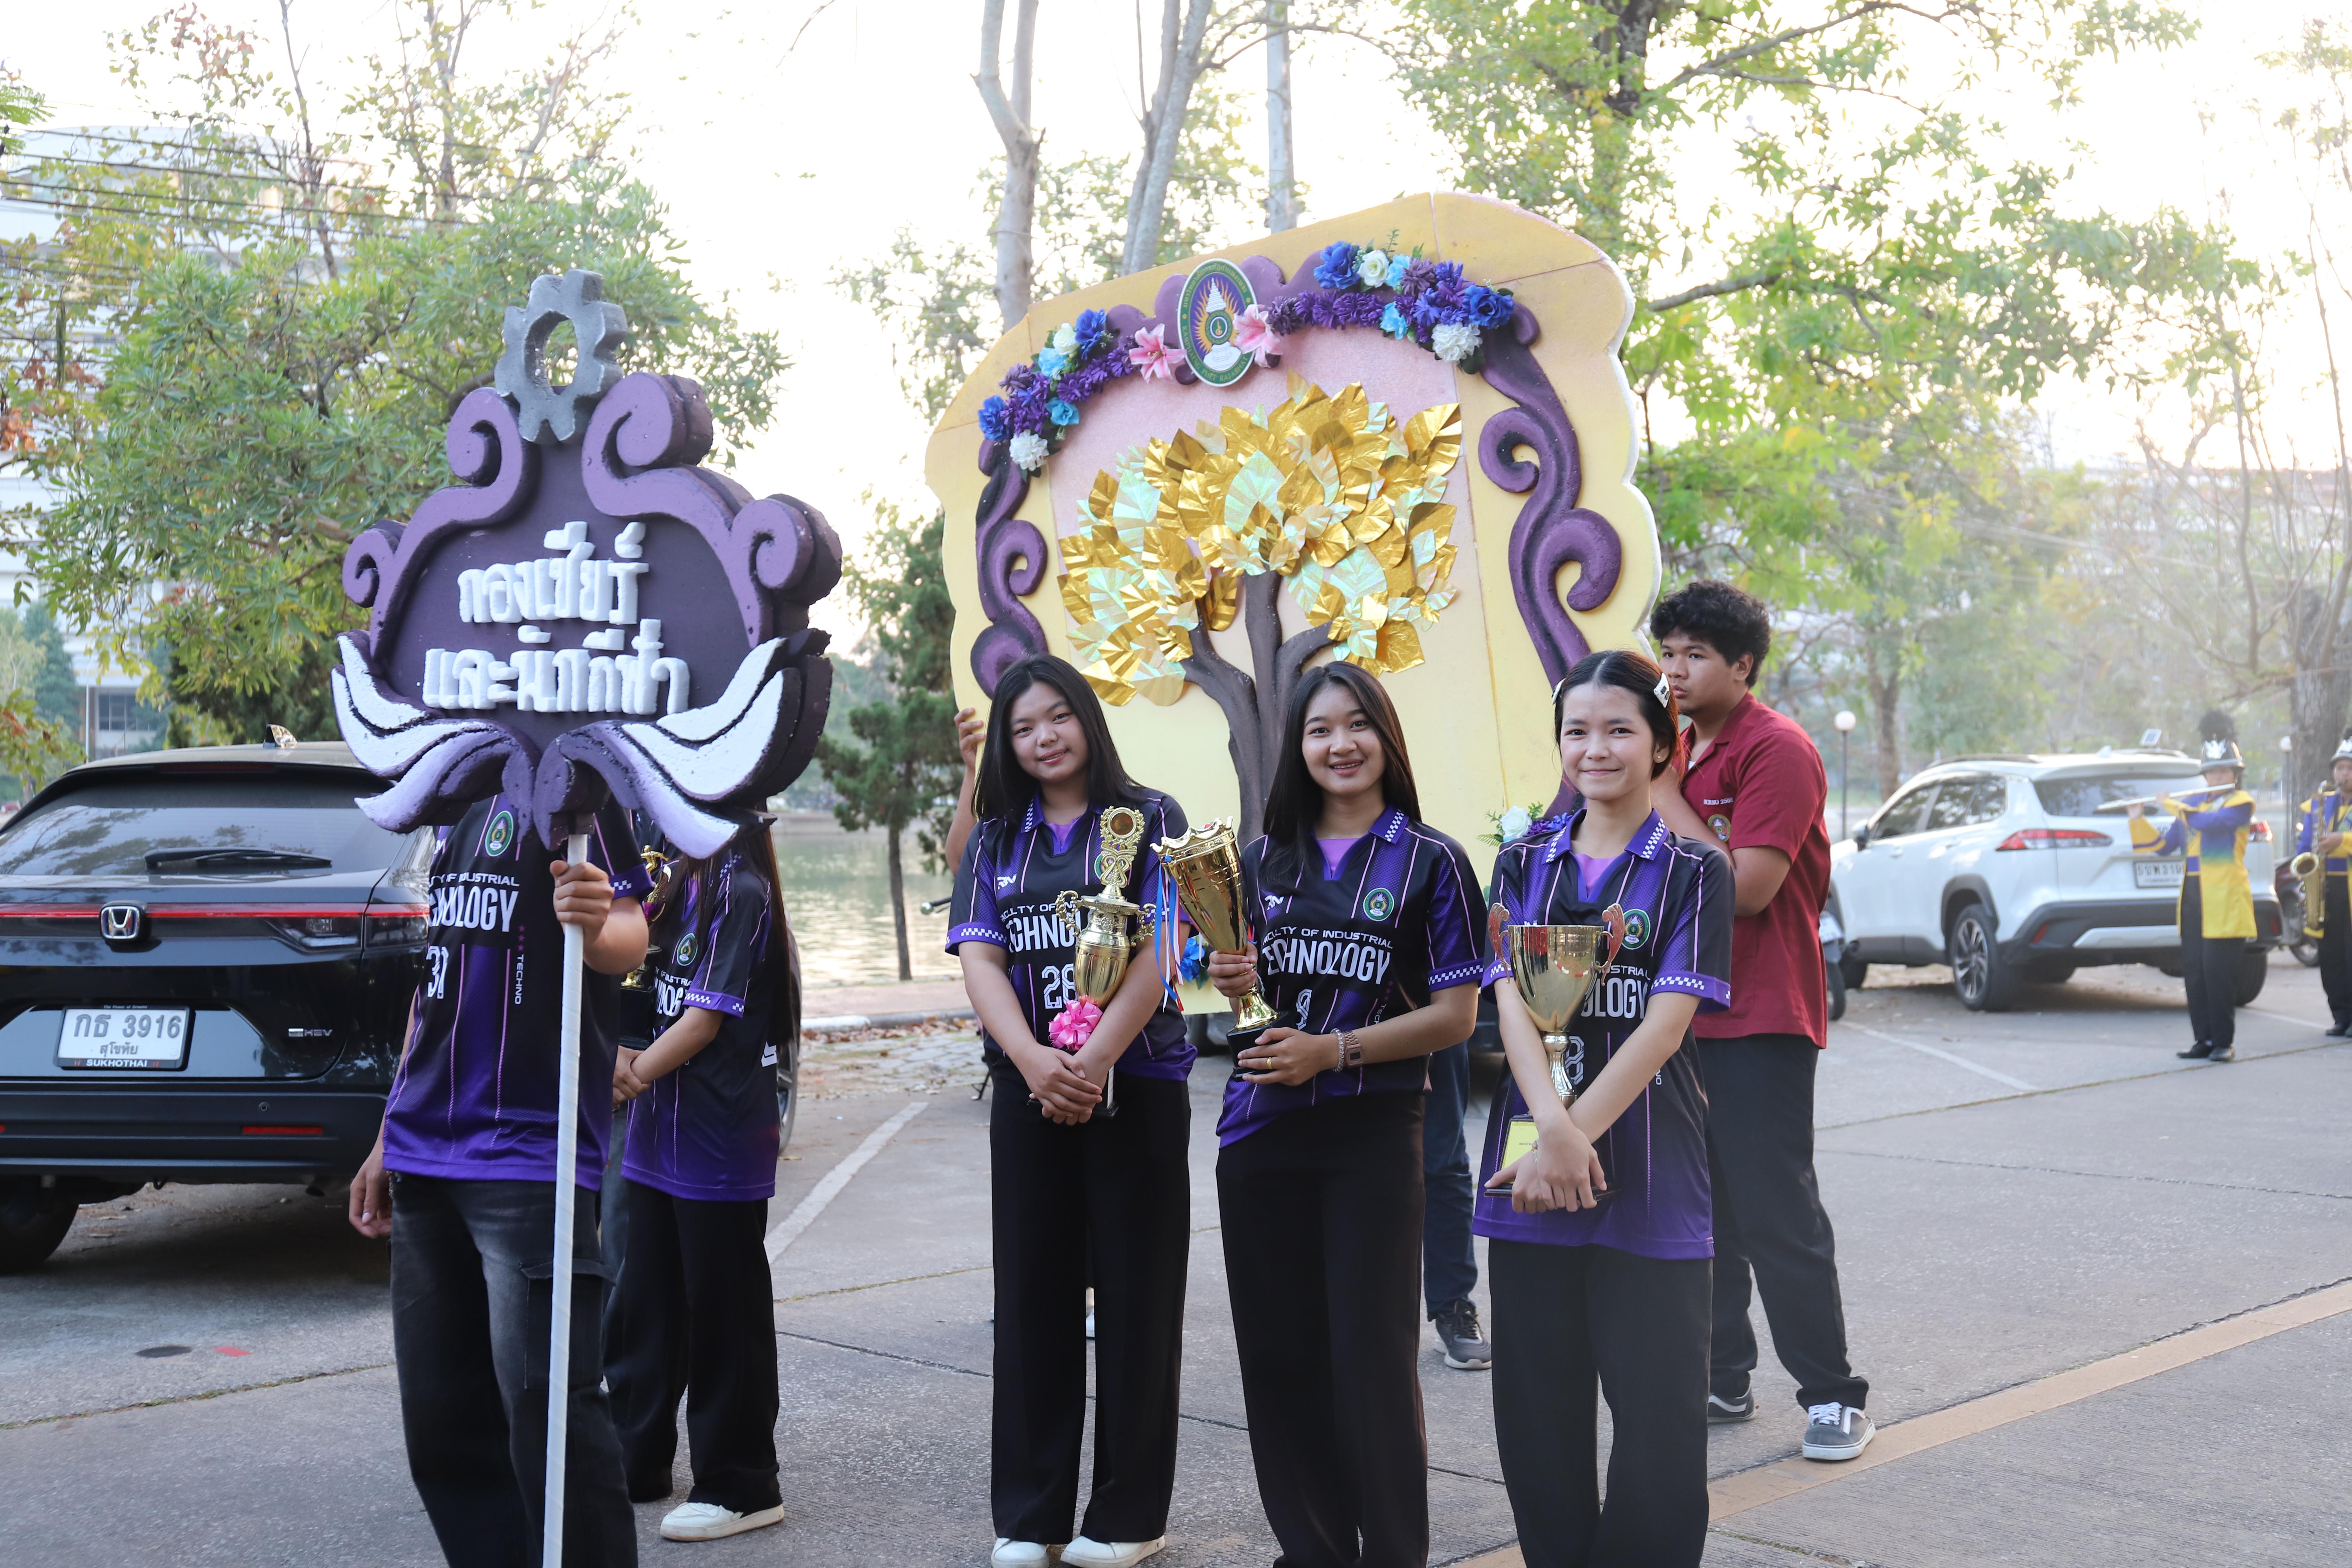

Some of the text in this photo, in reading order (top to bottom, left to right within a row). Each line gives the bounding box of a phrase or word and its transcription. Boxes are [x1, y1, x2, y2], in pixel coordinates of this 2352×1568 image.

[457, 521, 649, 626] กองเชียร์
[422, 618, 691, 715] และนักกีฬา
[1301, 928, 1319, 937] OF
[1322, 929, 1393, 949] INDUSTRIAL
[514, 954, 524, 1004] TECHNO
[74, 1014, 181, 1038] กธ 3916
[100, 1041, 138, 1057] สุโขทัย
[86, 1059, 148, 1068] SUKHOTHAI
